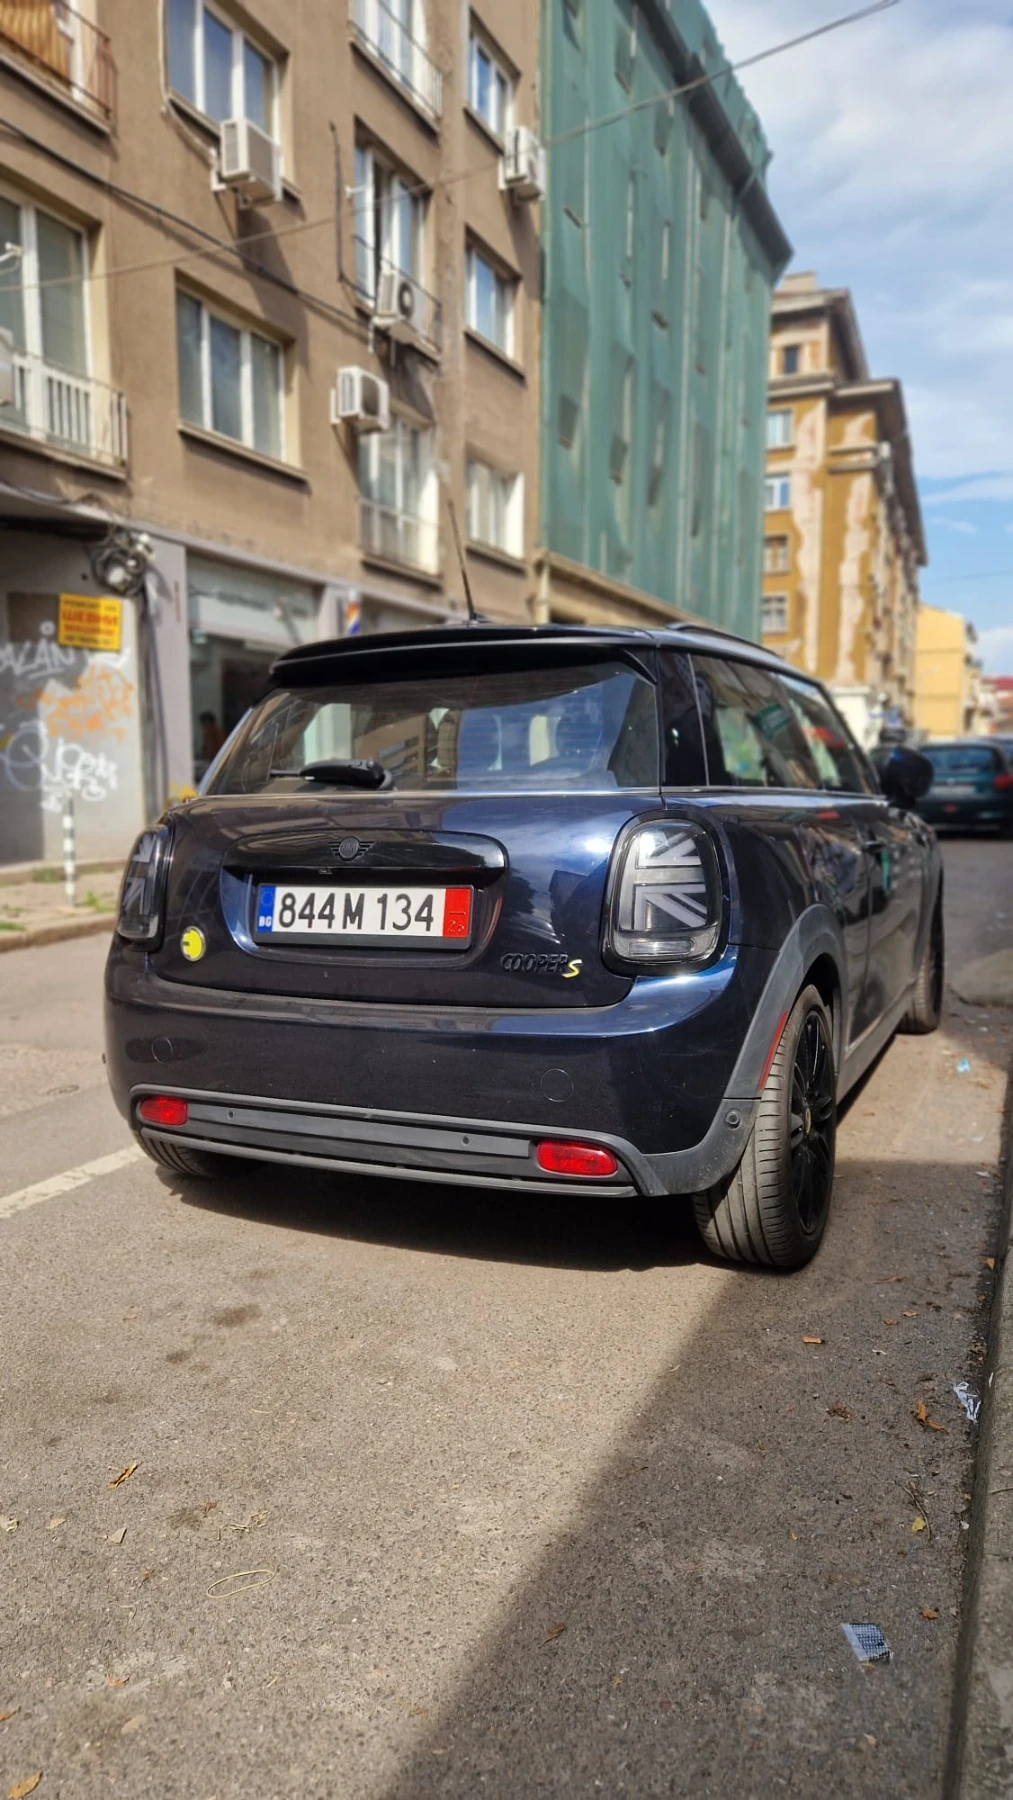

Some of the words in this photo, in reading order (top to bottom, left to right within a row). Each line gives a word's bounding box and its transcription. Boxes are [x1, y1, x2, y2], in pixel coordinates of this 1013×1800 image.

[259, 915, 272, 927] BG
[501, 953, 568, 973] COOPER
[561, 959, 583, 978] S
